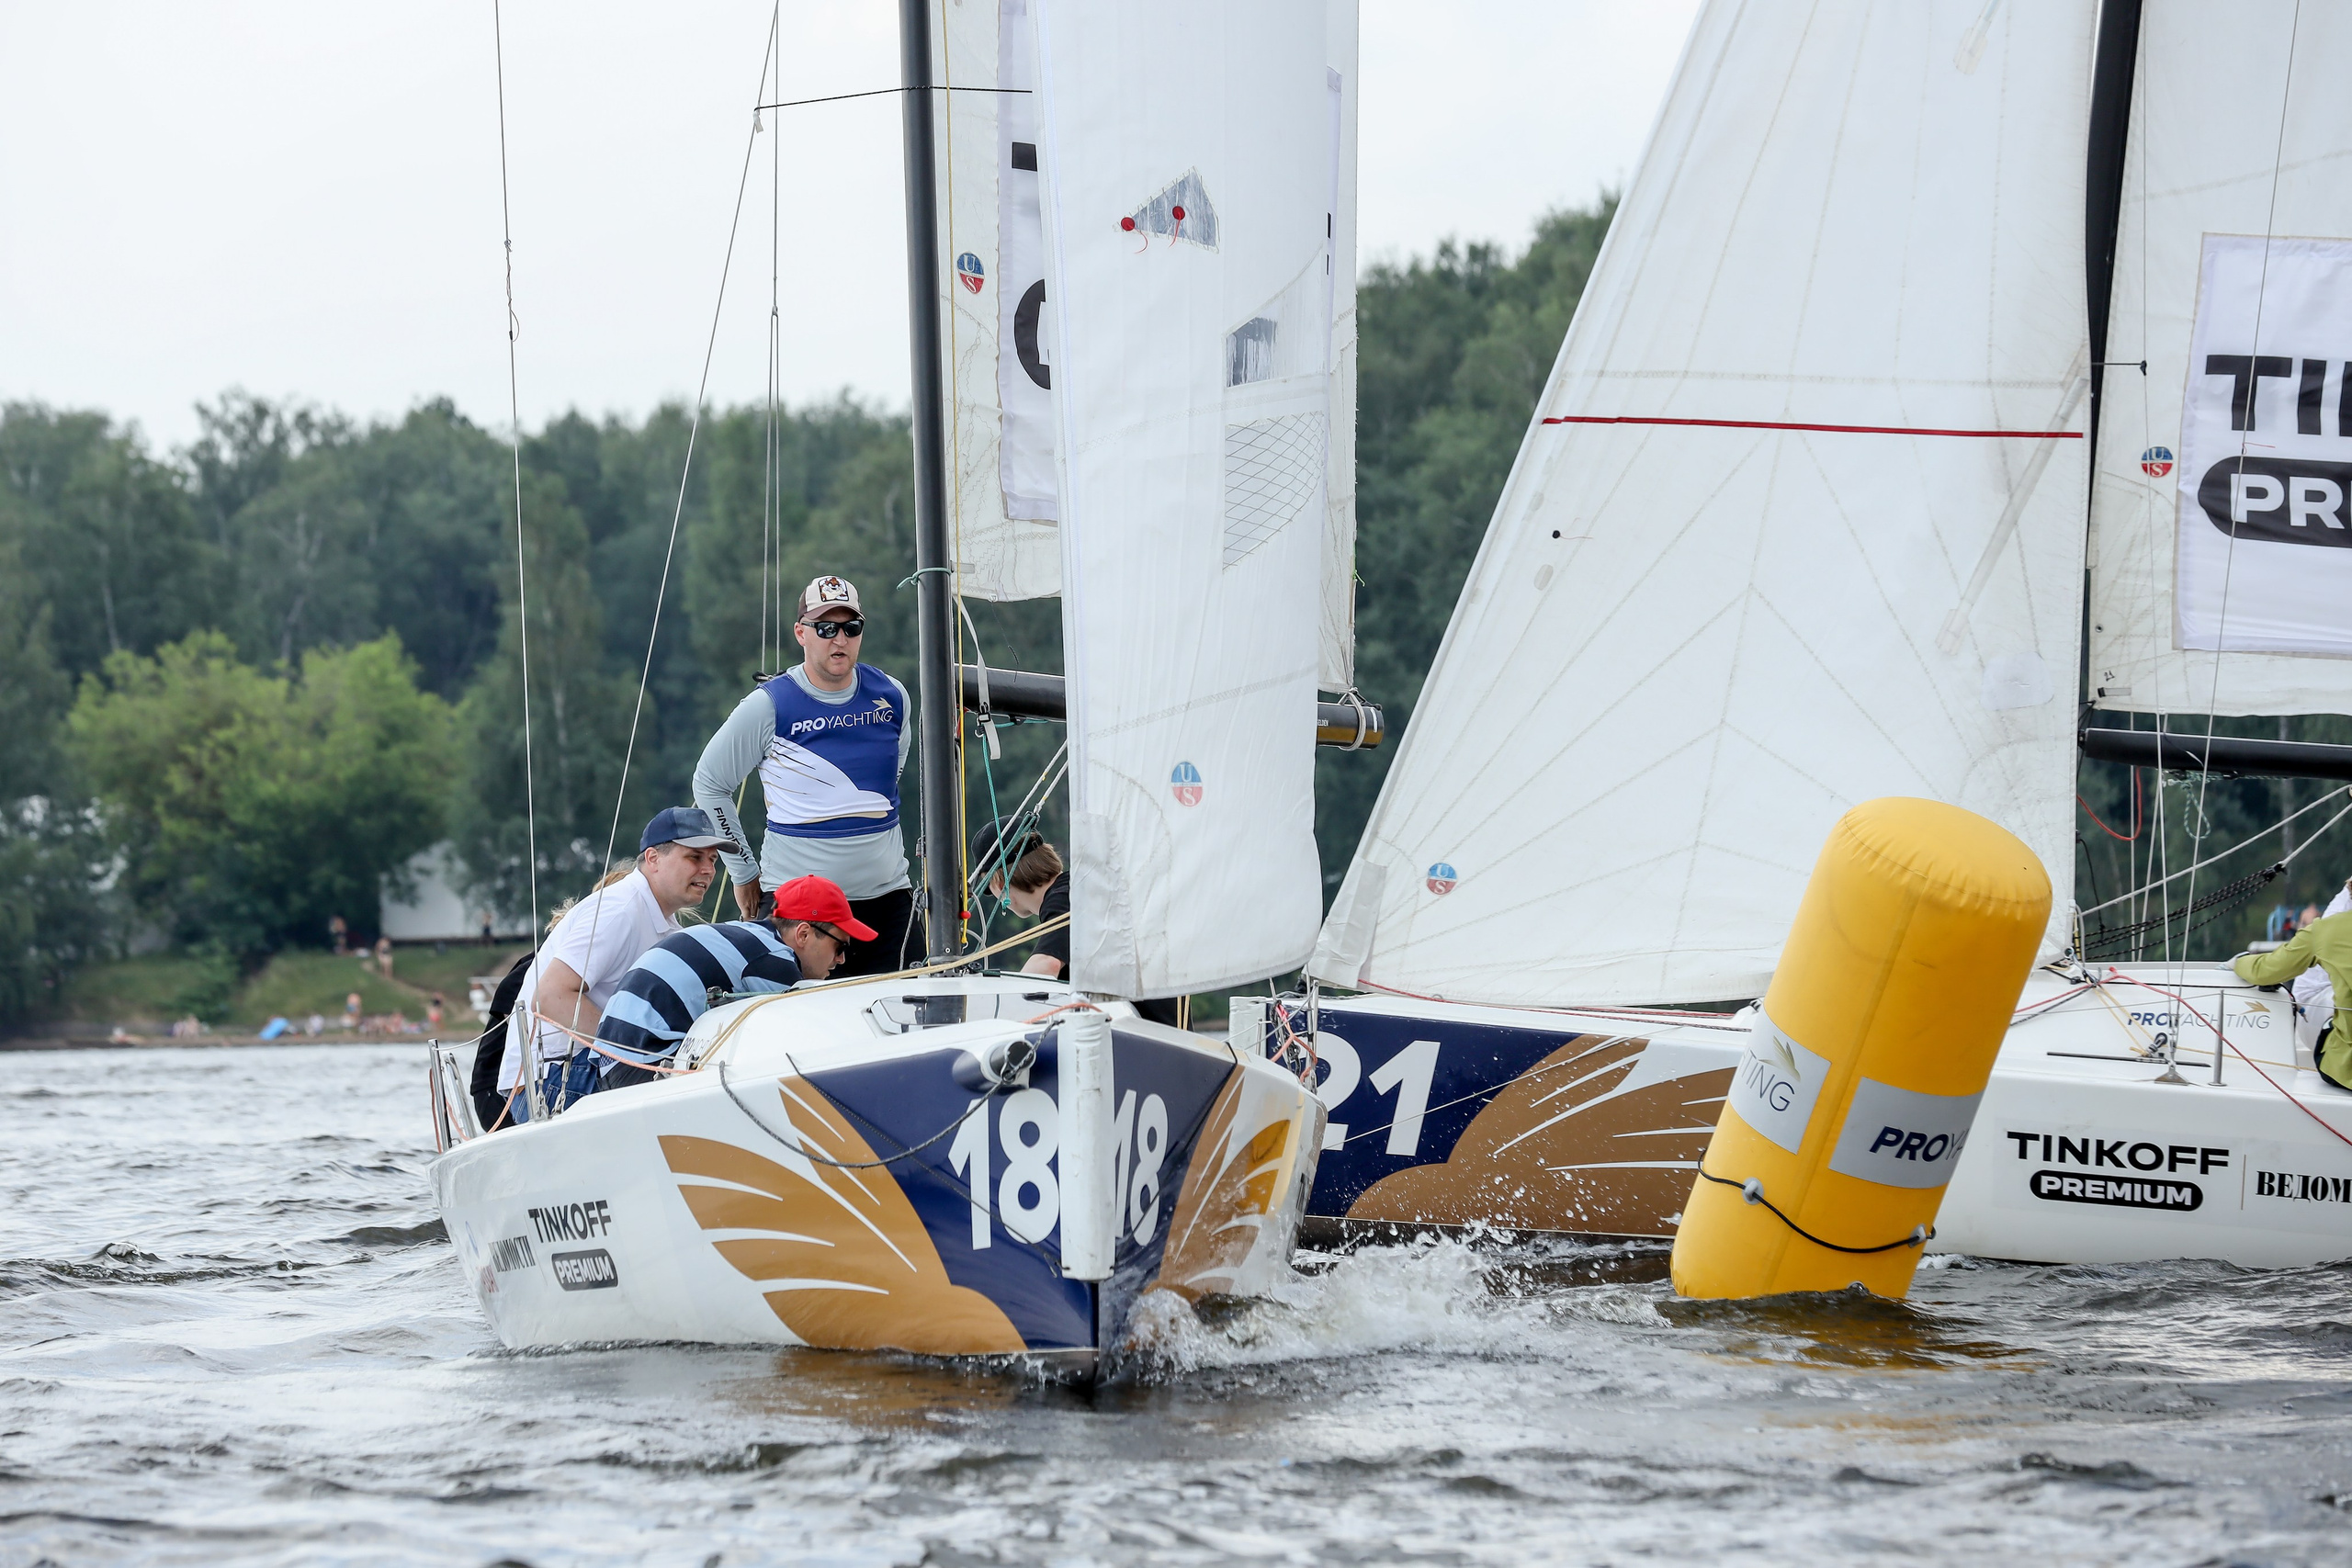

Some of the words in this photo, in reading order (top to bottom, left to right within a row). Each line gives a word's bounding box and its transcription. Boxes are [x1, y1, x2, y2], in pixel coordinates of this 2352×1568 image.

[2205, 355, 2352, 436] TI
[2230, 473, 2352, 529] PR
[790, 709, 894, 736] PROYACHTING
[1289, 1031, 1442, 1156] 21
[947, 1088, 1060, 1251] 18
[1114, 1089, 1169, 1247] 18
[2007, 1131, 2230, 1175] TINKOFF
[2040, 1175, 2193, 1206] PREMIUM
[2255, 1170, 2352, 1203] ВЕДОМ
[527, 1200, 612, 1244] TINKOFF
[554, 1255, 615, 1285] PREMIUM
